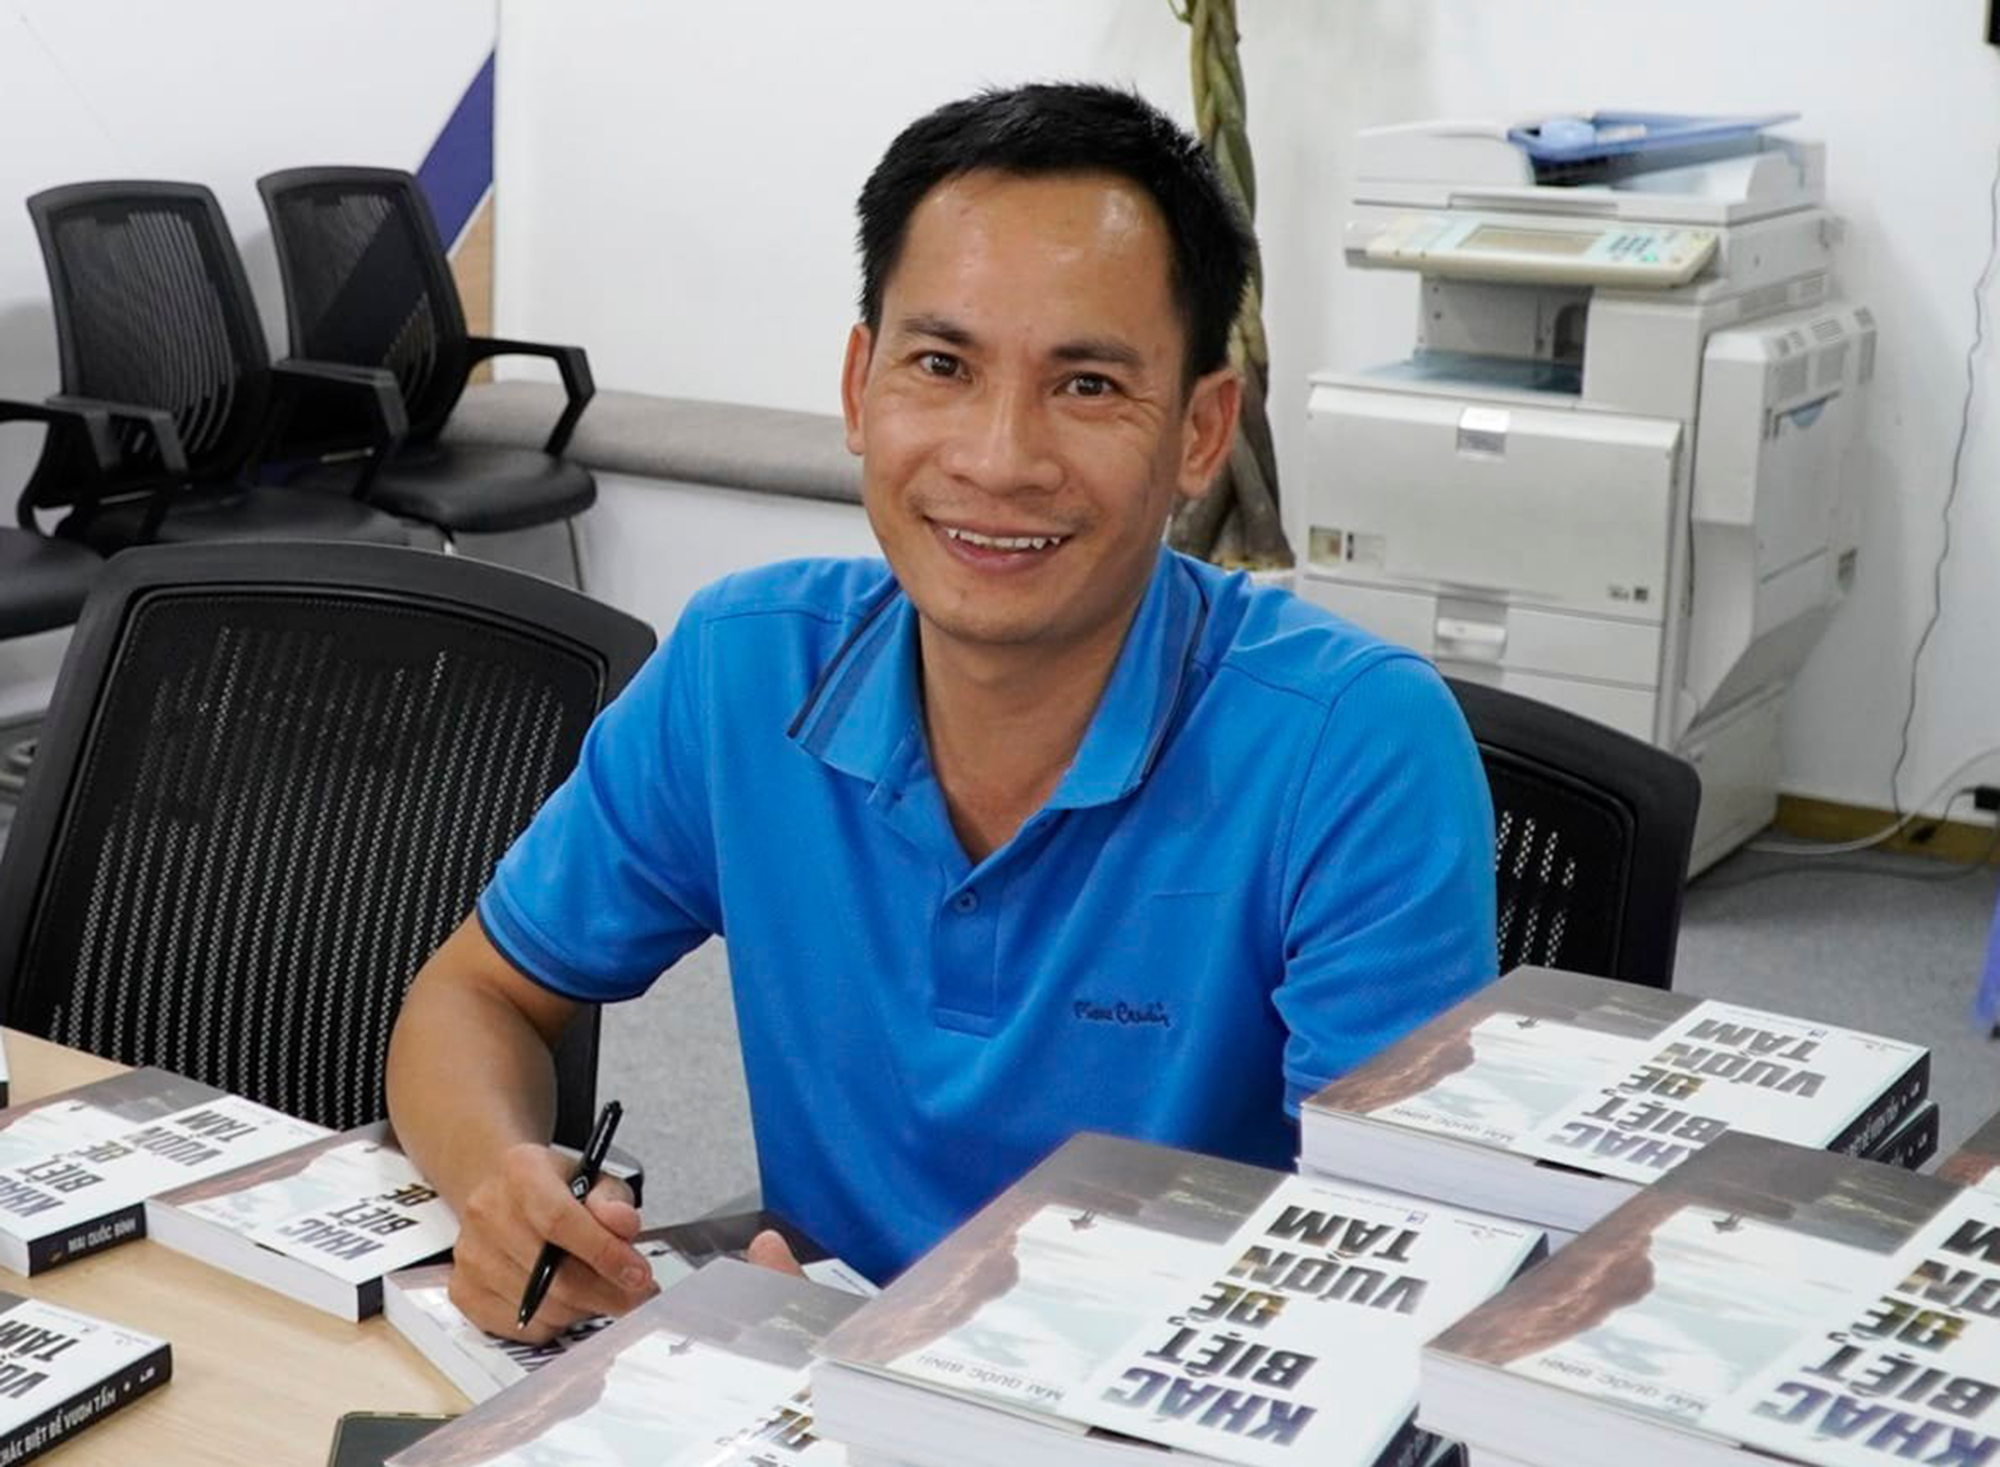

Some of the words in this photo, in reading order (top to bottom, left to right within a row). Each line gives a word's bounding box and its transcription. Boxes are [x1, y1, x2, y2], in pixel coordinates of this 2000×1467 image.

[1651, 1042, 1826, 1098] VƯƠN
[1581, 1096, 1730, 1142] BIỆT
[1545, 1122, 1690, 1169] HÁC
[15, 1159, 105, 1193] BIỆT
[326, 1202, 420, 1236] BIỆT
[1166, 1281, 1290, 1329] ĐỂ
[1226, 1245, 1428, 1315] VƯƠN
[1827, 1296, 1970, 1353] ĐỂ
[1143, 1326, 1318, 1391] BIỆT
[1799, 1344, 2000, 1418] BIỆT
[1026, 1383, 1067, 1401] MAI
[1101, 1367, 1318, 1446] KHÁC
